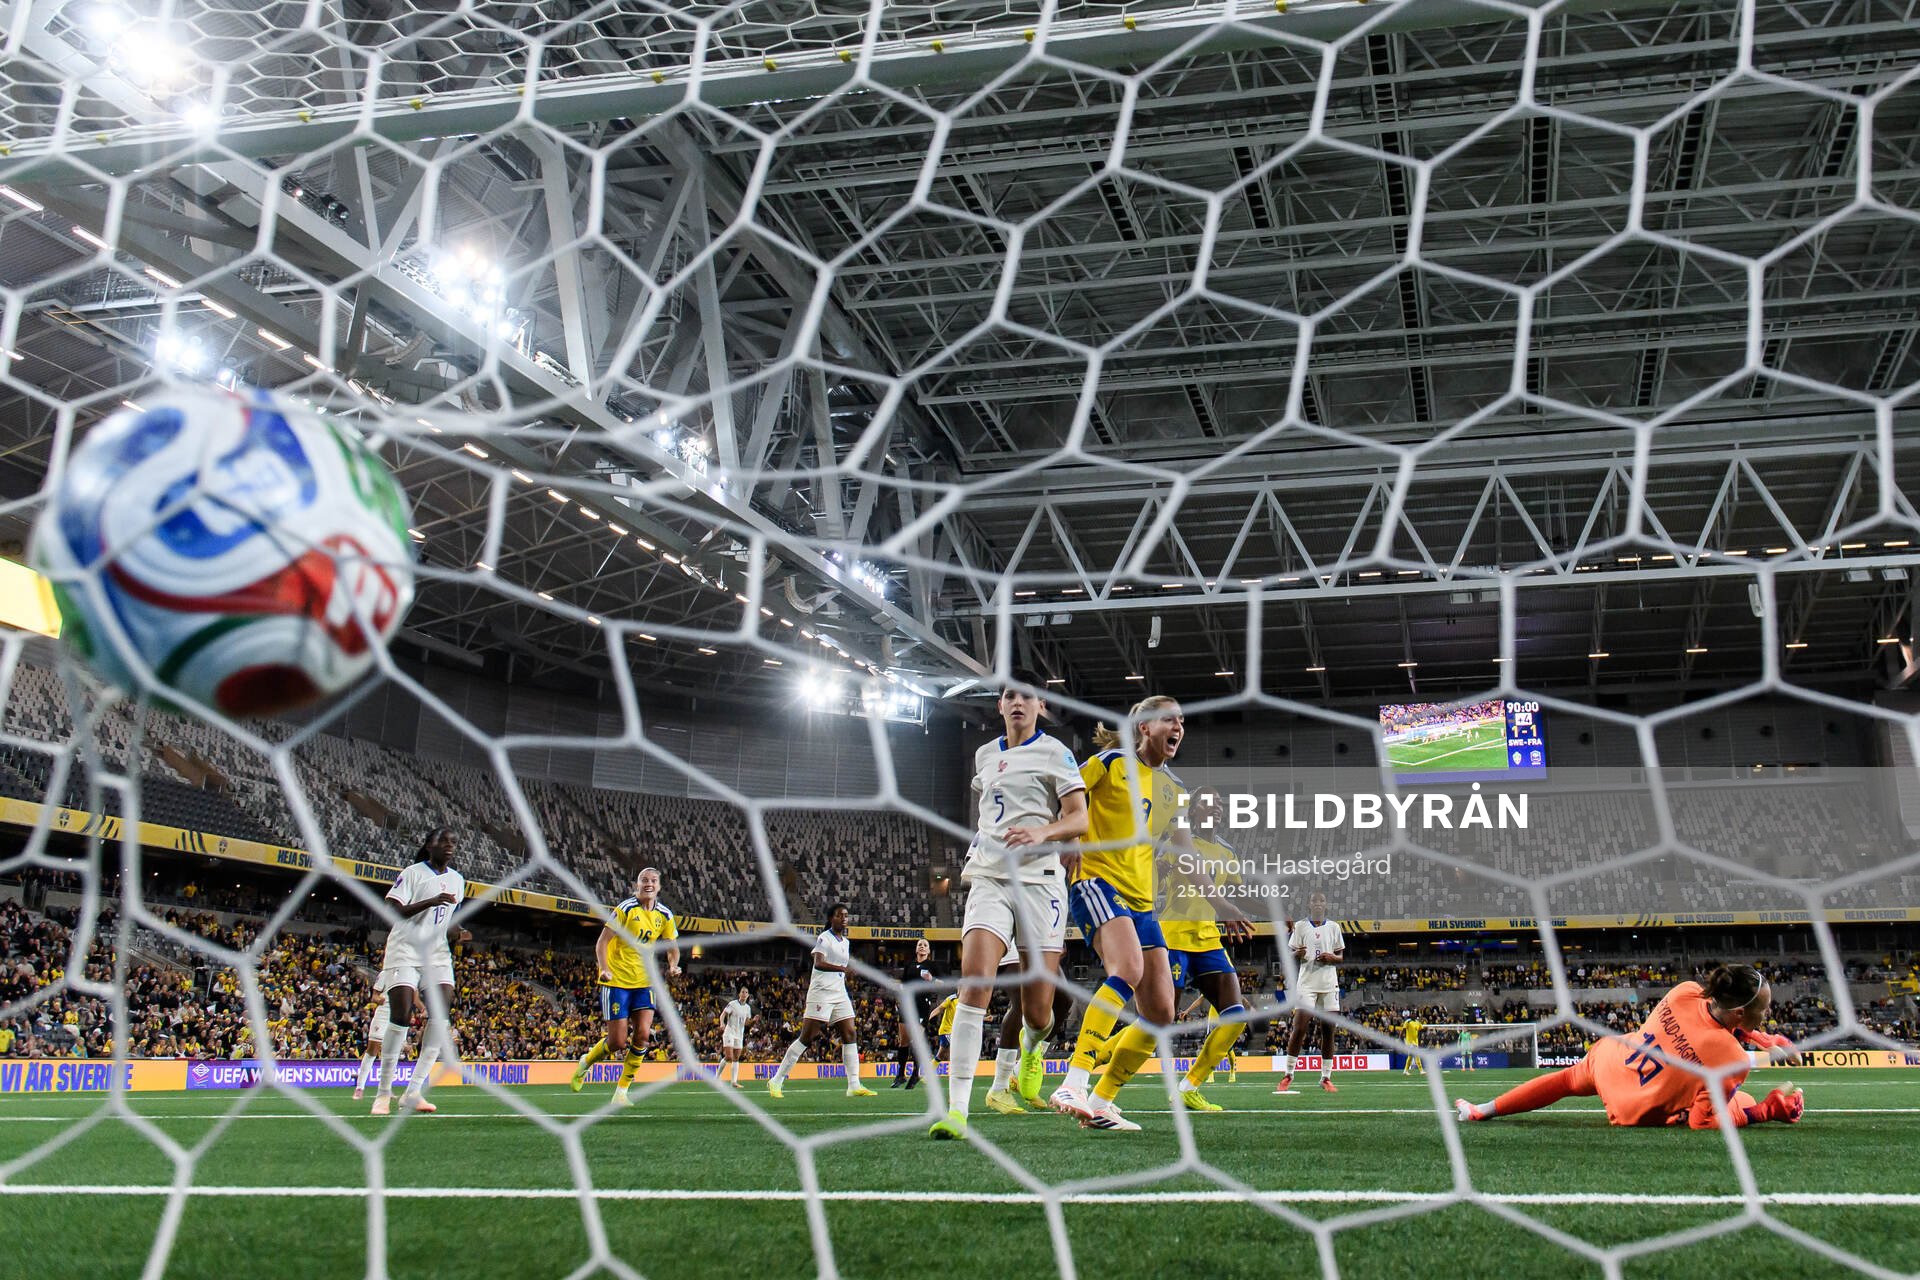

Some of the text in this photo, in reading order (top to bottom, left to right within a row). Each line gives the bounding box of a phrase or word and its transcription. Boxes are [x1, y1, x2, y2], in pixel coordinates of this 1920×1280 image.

[1506, 702, 1539, 713] 90:00
[994, 794, 1004, 823] 5
[433, 906, 446, 925] 19
[1051, 899, 1060, 928] 5
[1674, 914, 1694, 924] HEJA
[1429, 920, 1486, 929] HEJA SVERIGE!
[871, 929, 879, 938] VI
[892, 928, 925, 939] SVERIGE
[1297, 1058, 1366, 1069] CRMO
[1625, 1032, 1664, 1087] 16
[1, 1062, 134, 1092] VI ÄR SVERIE
[213, 1068, 249, 1083] UEFA
[249, 1068, 313, 1082] WMEN'S
[876, 1064, 887, 1077] VI
